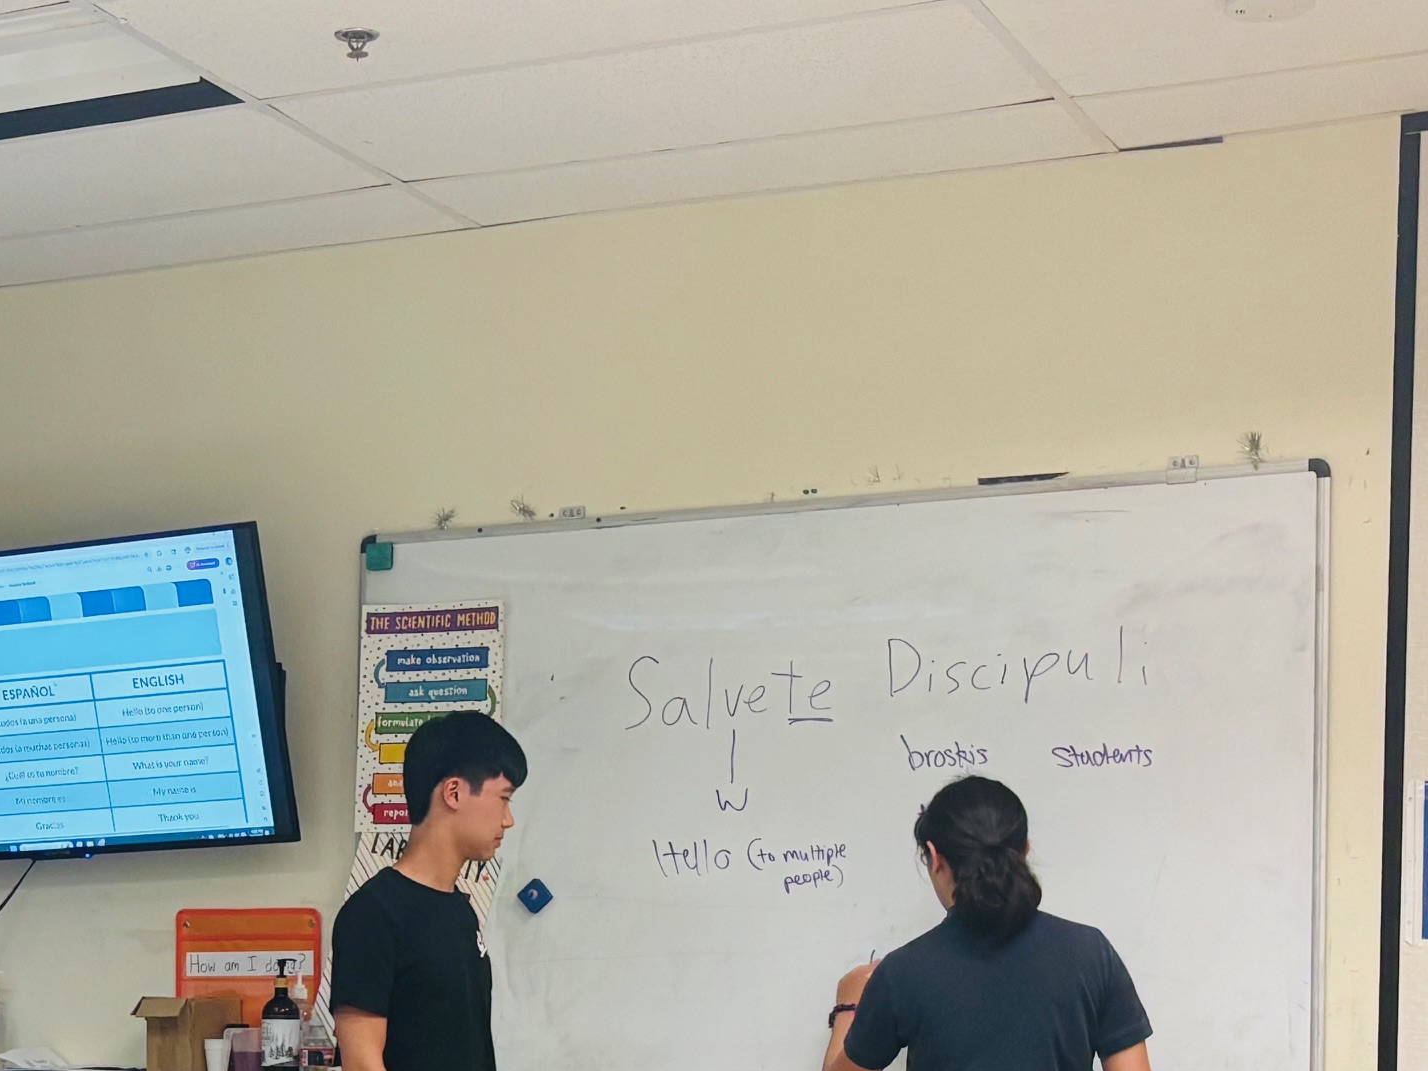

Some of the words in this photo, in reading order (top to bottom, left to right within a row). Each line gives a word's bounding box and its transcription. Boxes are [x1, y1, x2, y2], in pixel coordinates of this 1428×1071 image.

[370, 616, 390, 630] THE
[395, 614, 451, 630] SCIENTIFIC
[457, 611, 496, 627] METHOD
[398, 654, 421, 665] make
[426, 653, 480, 664] observation
[132, 673, 185, 689] ENGLISH
[625, 655, 831, 729] Salvete
[888, 625, 1147, 704] Discipuli
[2, 685, 55, 700] ESPAÑOL
[409, 686, 425, 697] ask
[428, 686, 468, 700] question
[122, 707, 144, 717] Hello
[144, 706, 156, 716] (to
[157, 705, 172, 714] one
[172, 702, 204, 714] person)
[378, 716, 424, 727] formulate
[105, 736, 128, 746] Hello
[128, 735, 140, 744] (to
[162, 733, 181, 741] than
[181, 731, 197, 740] one
[198, 727, 229, 739] person)
[900, 734, 988, 771] broskis
[132, 761, 155, 771] What
[156, 760, 163, 769] is
[164, 759, 183, 769] your
[152, 787, 166, 796] My
[167, 787, 189, 795] name
[190, 786, 197, 794] is
[158, 813, 184, 823] Thank
[185, 813, 199, 823] you
[652, 838, 732, 877] Hello
[747, 837, 776, 871] (to
[783, 843, 847, 867] multiple
[784, 864, 844, 894] people)
[189, 954, 216, 974] How
[224, 961, 240, 972] am
[247, 955, 257, 972] I
